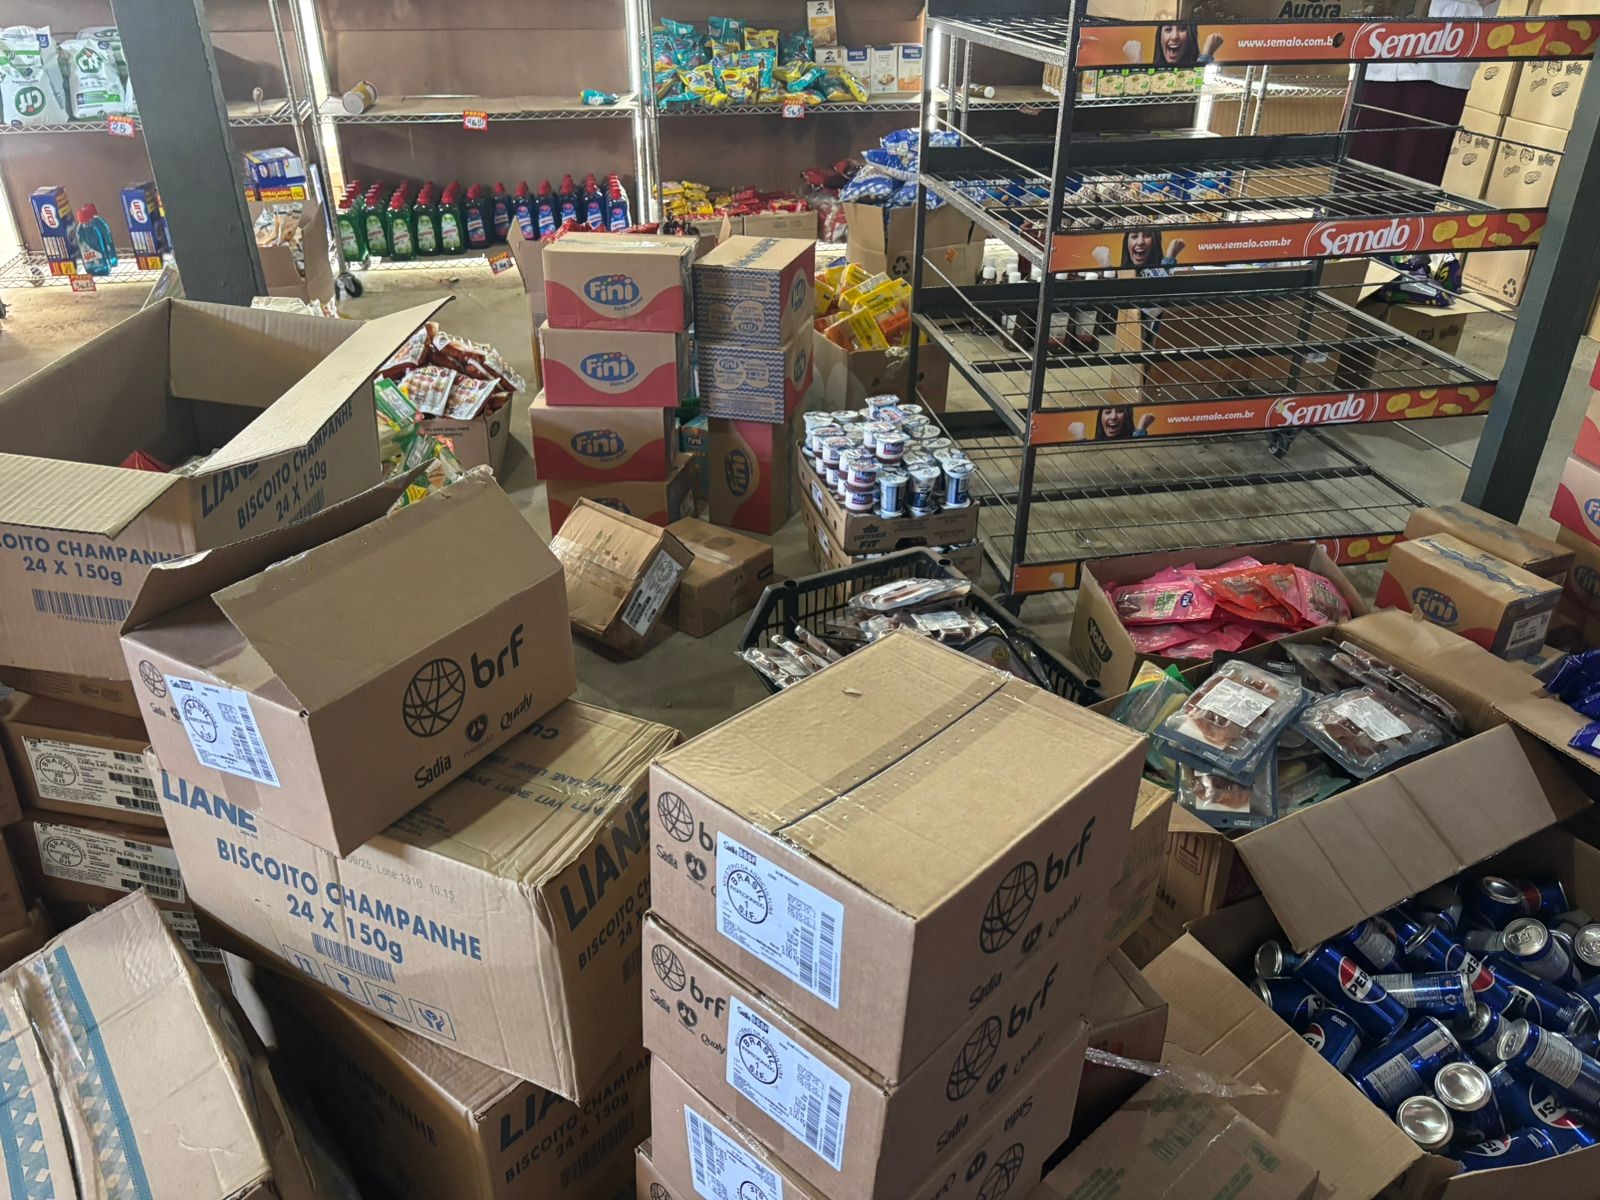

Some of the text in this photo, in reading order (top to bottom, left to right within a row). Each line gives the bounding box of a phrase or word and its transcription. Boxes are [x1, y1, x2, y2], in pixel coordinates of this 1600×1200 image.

[1278, 1, 1341, 18] Aurora
[1237, 36, 1335, 49] www.semalo.com.b
[1366, 22, 1464, 58] Semalo
[19, 90, 43, 113] Cif
[43, 205, 56, 227] urca
[133, 201, 145, 222] urca
[1197, 237, 1292, 251] www.semalo.com.br
[1316, 217, 1410, 256] Semalo
[588, 276, 634, 302] Fini
[585, 354, 629, 378] Fini
[1167, 411, 1255, 424] www.semalo.com.br
[1278, 393, 1365, 427] Semalo
[575, 432, 618, 454] Fini
[237, 401, 353, 530] BISCOITO CHAMPANHE
[276, 459, 327, 522] 24 X 150g
[0, 533, 181, 566] OITO CHAMPANH
[23, 556, 122, 586] 24 X 150g
[1415, 590, 1456, 623] Fini
[470, 623, 524, 689] brf
[501, 692, 533, 731] Qualy
[414, 755, 451, 789] Sadia
[161, 768, 258, 834] LIANE
[560, 790, 650, 933] LIANE
[656, 844, 678, 869] Sadia
[1043, 816, 1096, 893] brf
[216, 837, 482, 962] BISCOITO CHAMPANHE
[731, 873, 765, 901] BRASIL
[287, 894, 403, 964] 24 X 150g
[578, 895, 634, 971] BISCOITO
[617, 921, 633, 946] 24
[690, 976, 727, 1019] brf
[968, 971, 1003, 1011] Sadia
[1006, 963, 1059, 1039] brf
[701, 1033, 726, 1055] Qualy
[742, 1037, 776, 1065] BRASIL
[500, 1090, 566, 1151] LIA
[936, 1113, 969, 1153] Sadia
[505, 1115, 578, 1184] BISCOITO
